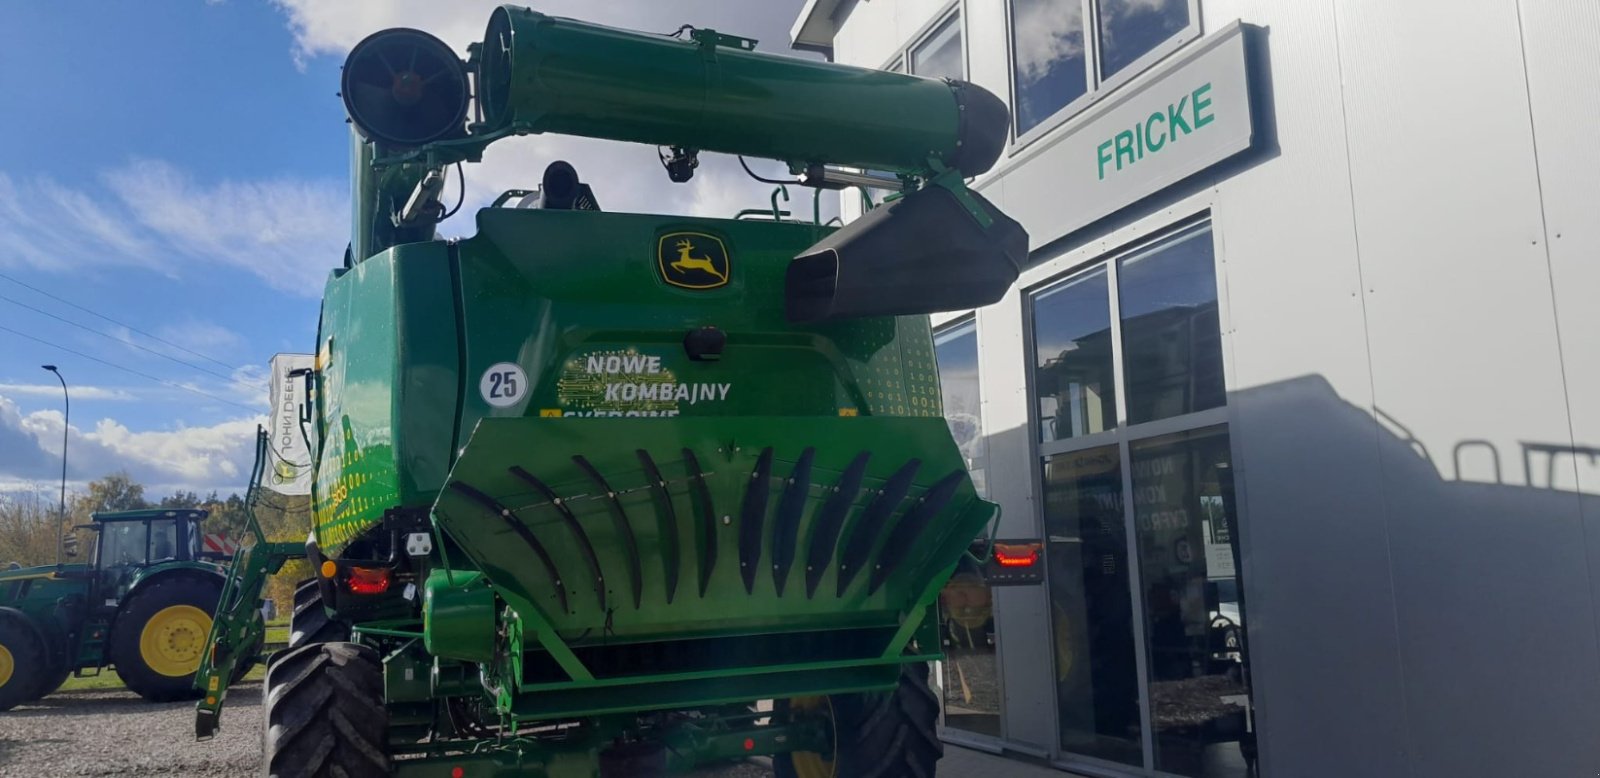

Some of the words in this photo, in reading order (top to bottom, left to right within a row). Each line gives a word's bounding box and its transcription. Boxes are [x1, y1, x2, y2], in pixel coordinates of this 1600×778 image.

[1097, 82, 1215, 180] FRICKE
[587, 356, 661, 374] NOWE
[489, 371, 517, 398] 25
[604, 383, 732, 405] KOMBAJNY
